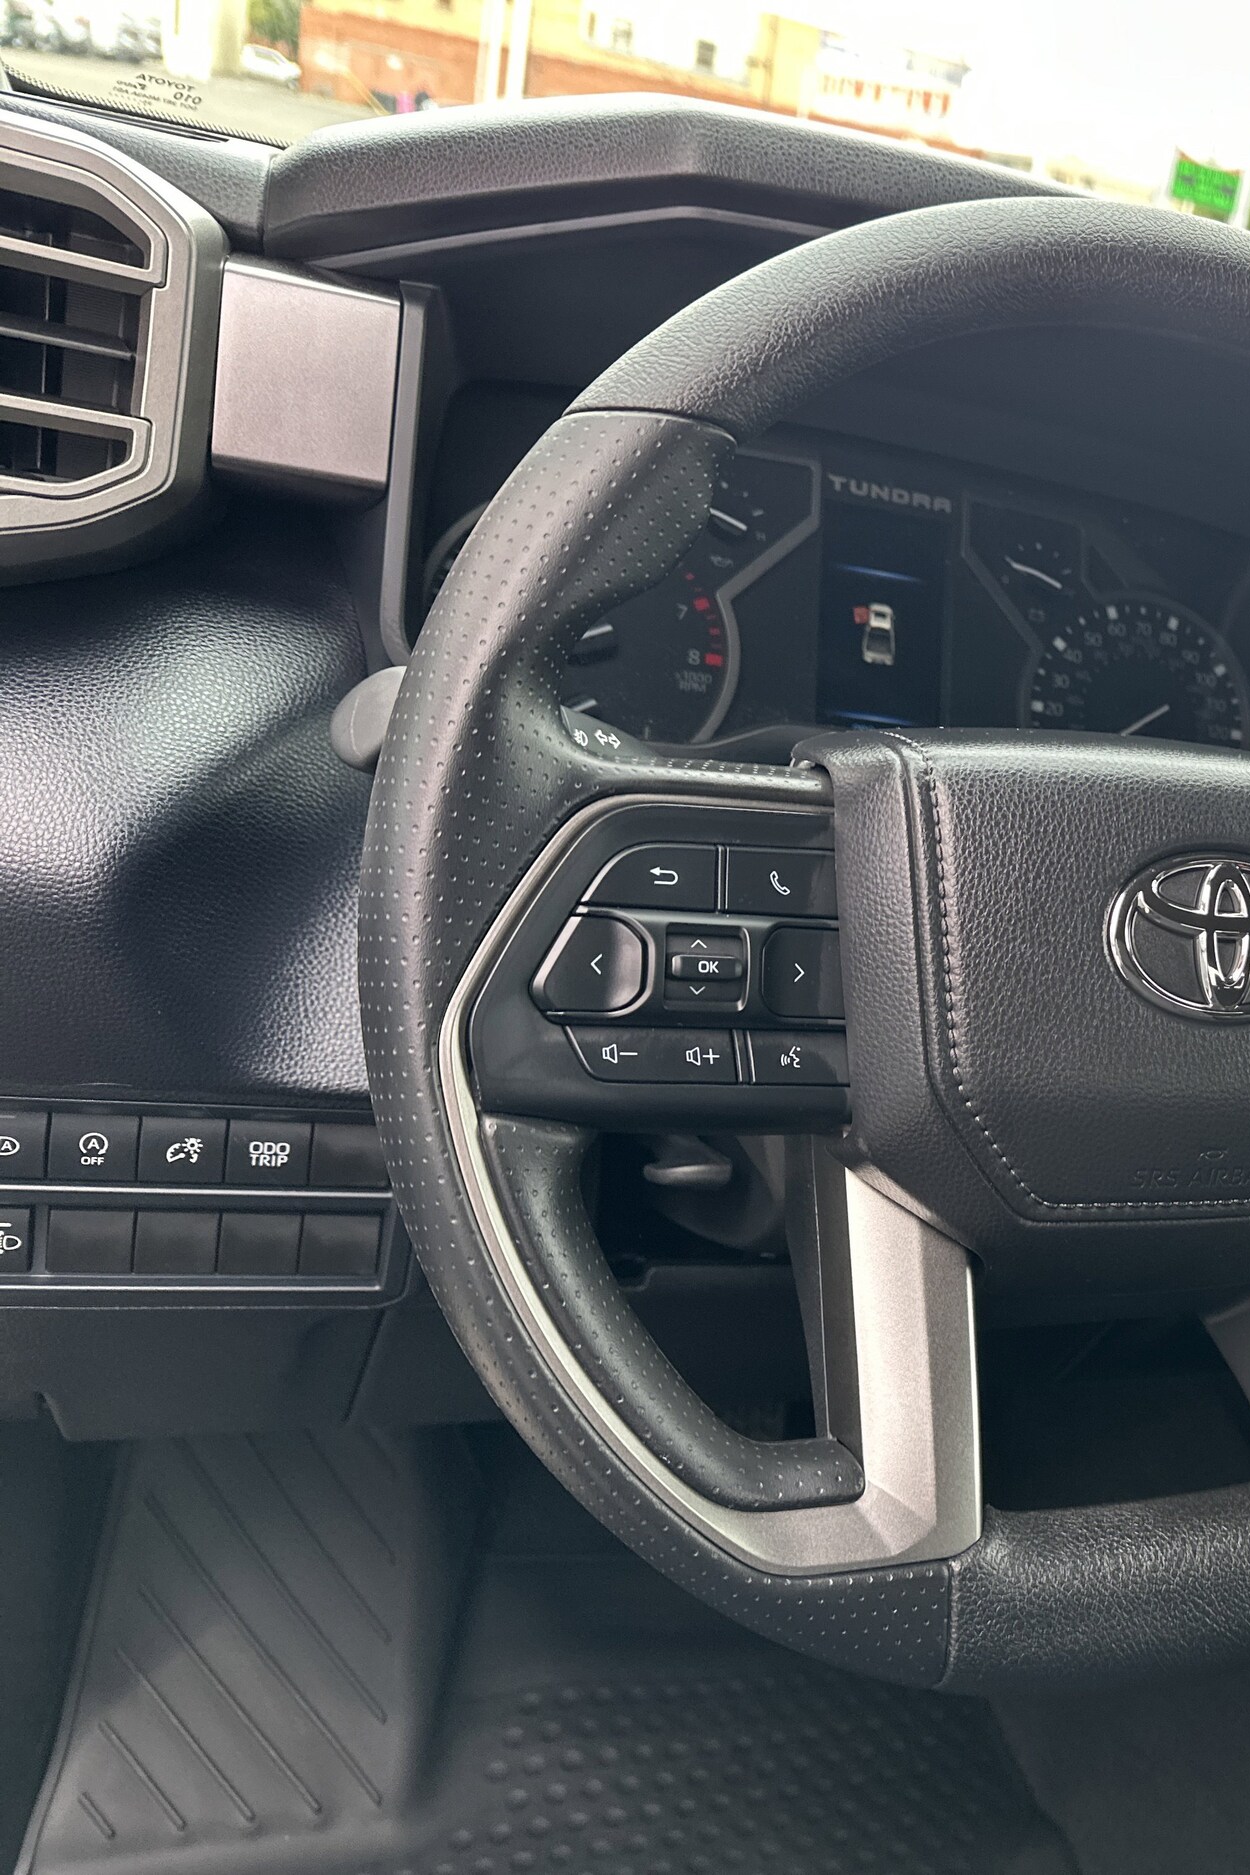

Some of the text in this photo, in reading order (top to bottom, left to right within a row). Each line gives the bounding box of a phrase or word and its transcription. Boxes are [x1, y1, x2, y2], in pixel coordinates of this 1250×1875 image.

[827, 473, 952, 513] TUNDRA
[674, 602, 688, 621] 7
[687, 649, 701, 666] 8
[698, 960, 719, 973] OK
[249, 1141, 291, 1156] ODO
[80, 1156, 105, 1166] OFF
[250, 1154, 288, 1167] TRIP
